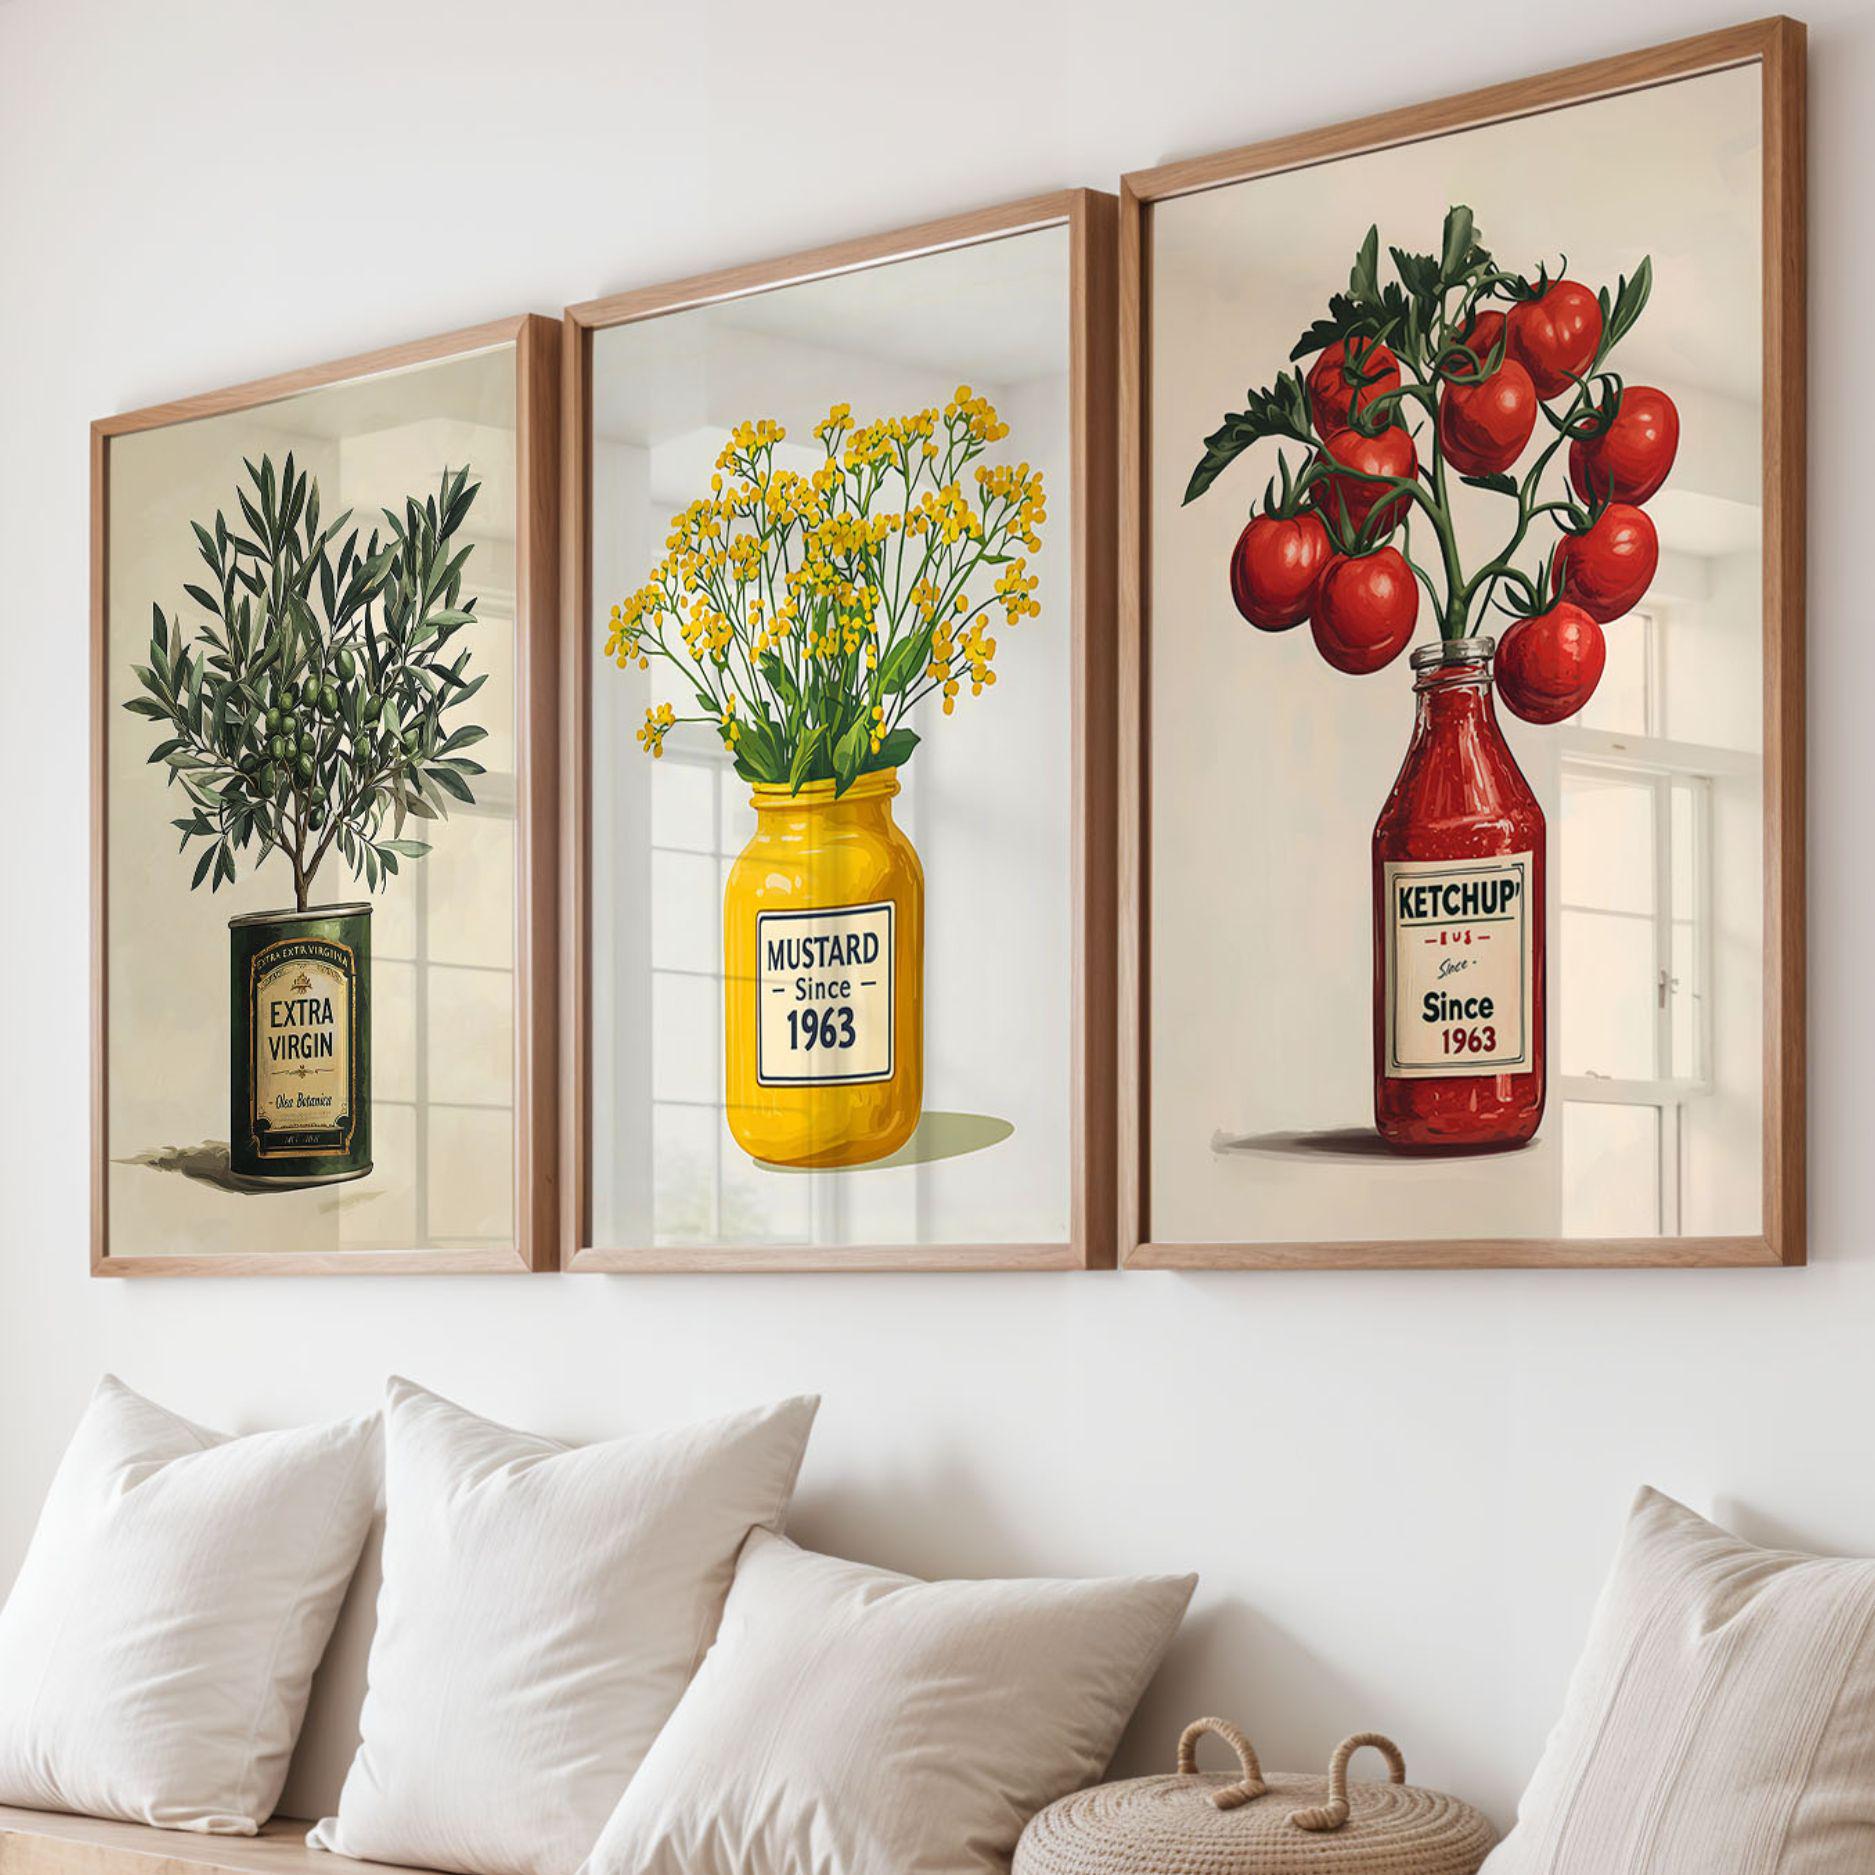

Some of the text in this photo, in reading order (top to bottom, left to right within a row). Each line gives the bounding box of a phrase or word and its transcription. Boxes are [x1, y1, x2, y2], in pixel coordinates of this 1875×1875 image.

[767, 932, 879, 971] MUSTARD
[795, 977, 851, 1001] Since
[270, 997, 334, 1028] EXTRA
[1422, 991, 1494, 1023] Since
[787, 1006, 856, 1051] 1963
[1442, 1026, 1496, 1054] 1963
[268, 1031, 333, 1060] VIRGIN
